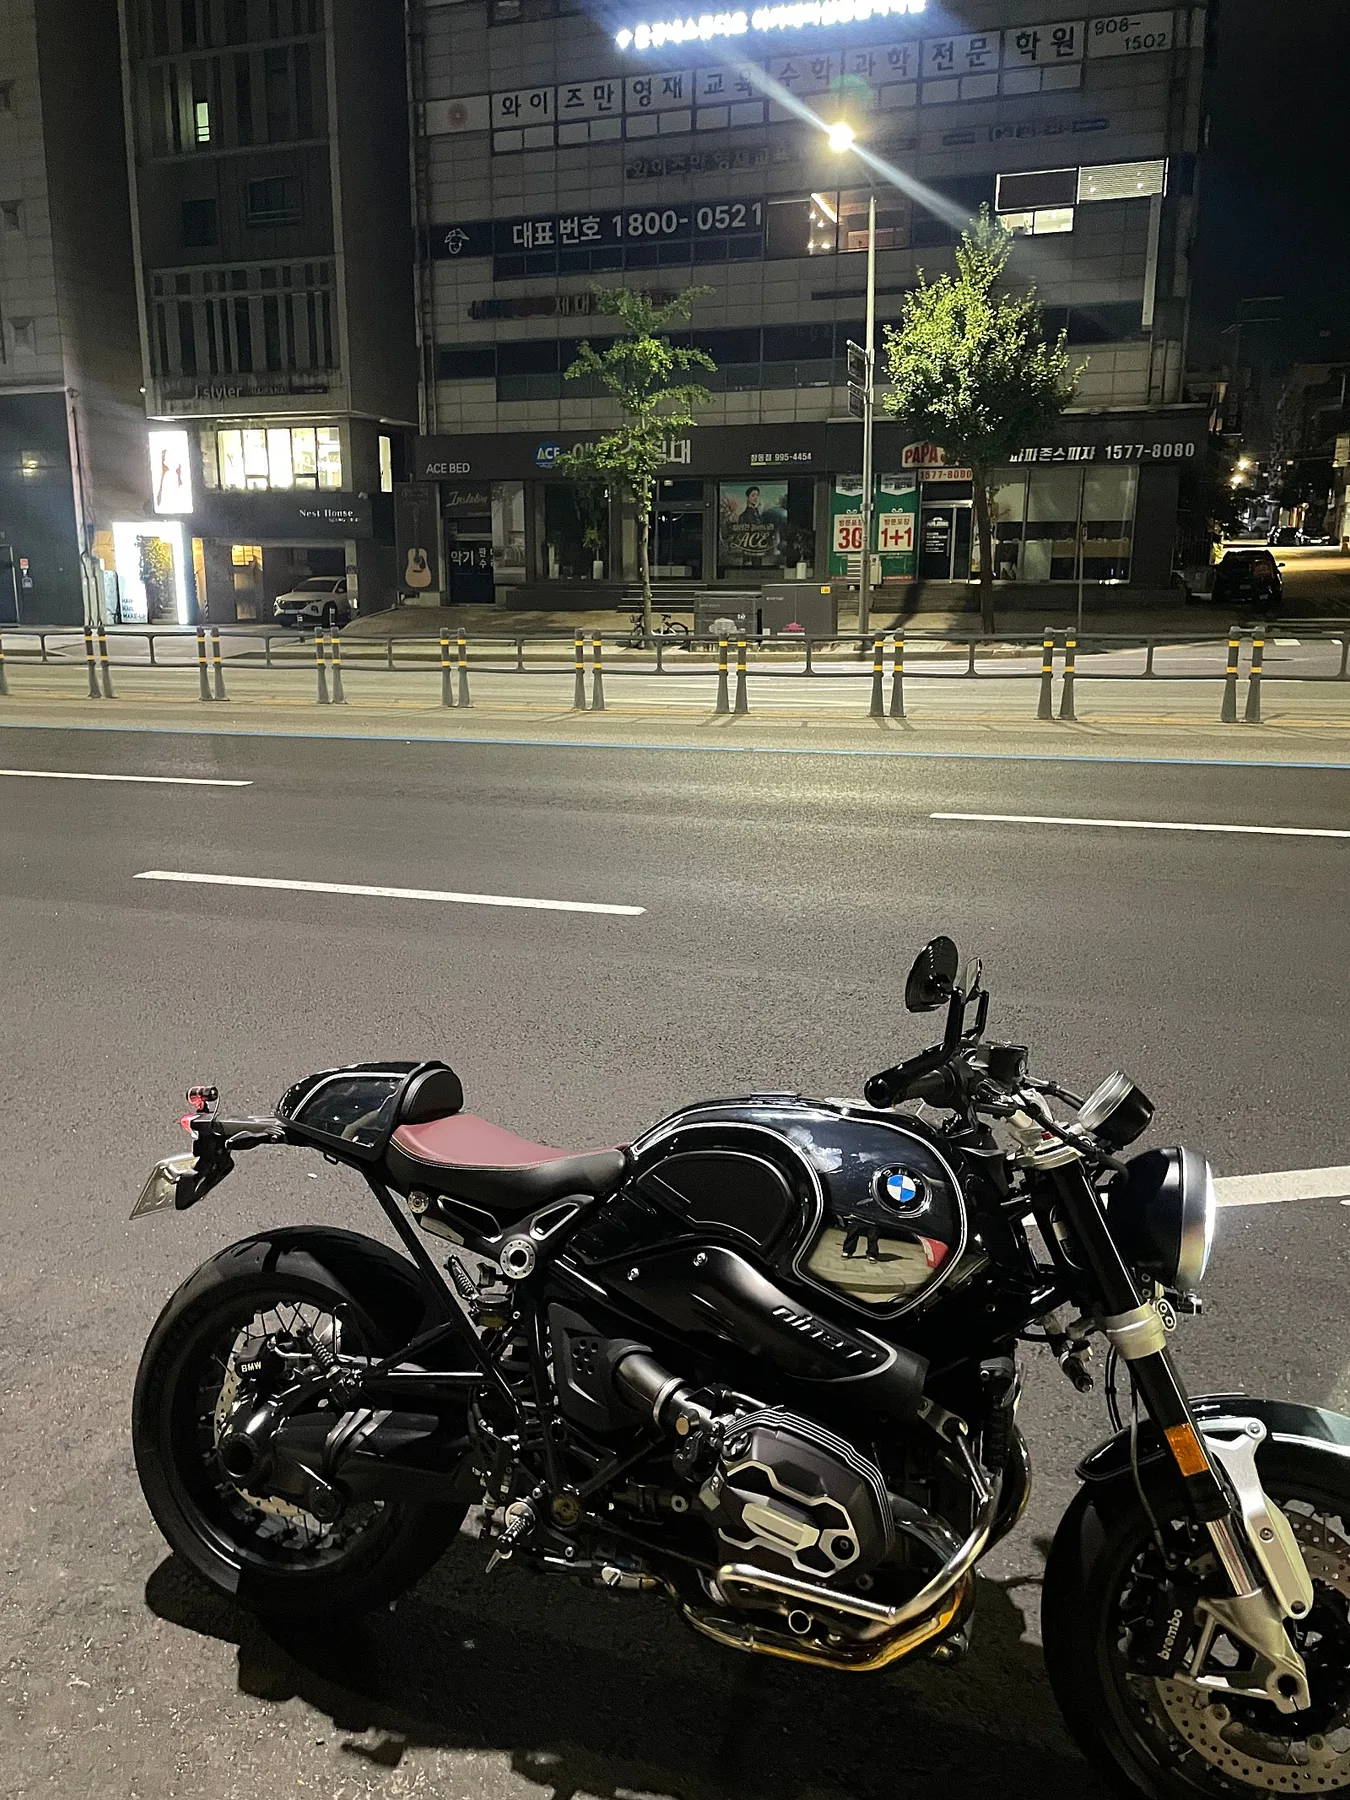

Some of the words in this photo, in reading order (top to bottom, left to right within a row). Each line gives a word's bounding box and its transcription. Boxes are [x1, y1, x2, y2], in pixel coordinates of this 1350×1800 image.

[1124, 34, 1167, 51] 1502
[774, 453, 812, 462] 995-4454
[904, 445, 939, 463] PAPA
[1105, 443, 1196, 460] 1577-8080
[426, 463, 448, 474] ACE
[449, 462, 471, 473] BED
[921, 470, 973, 481] 1577-8080
[299, 509, 321, 518] Nest
[324, 509, 354, 518] House
[881, 527, 912, 548] 1+1
[450, 550, 474, 566] 악기
[240, 1361, 262, 1373] BMW
[1156, 1608, 1183, 1661] brembo
